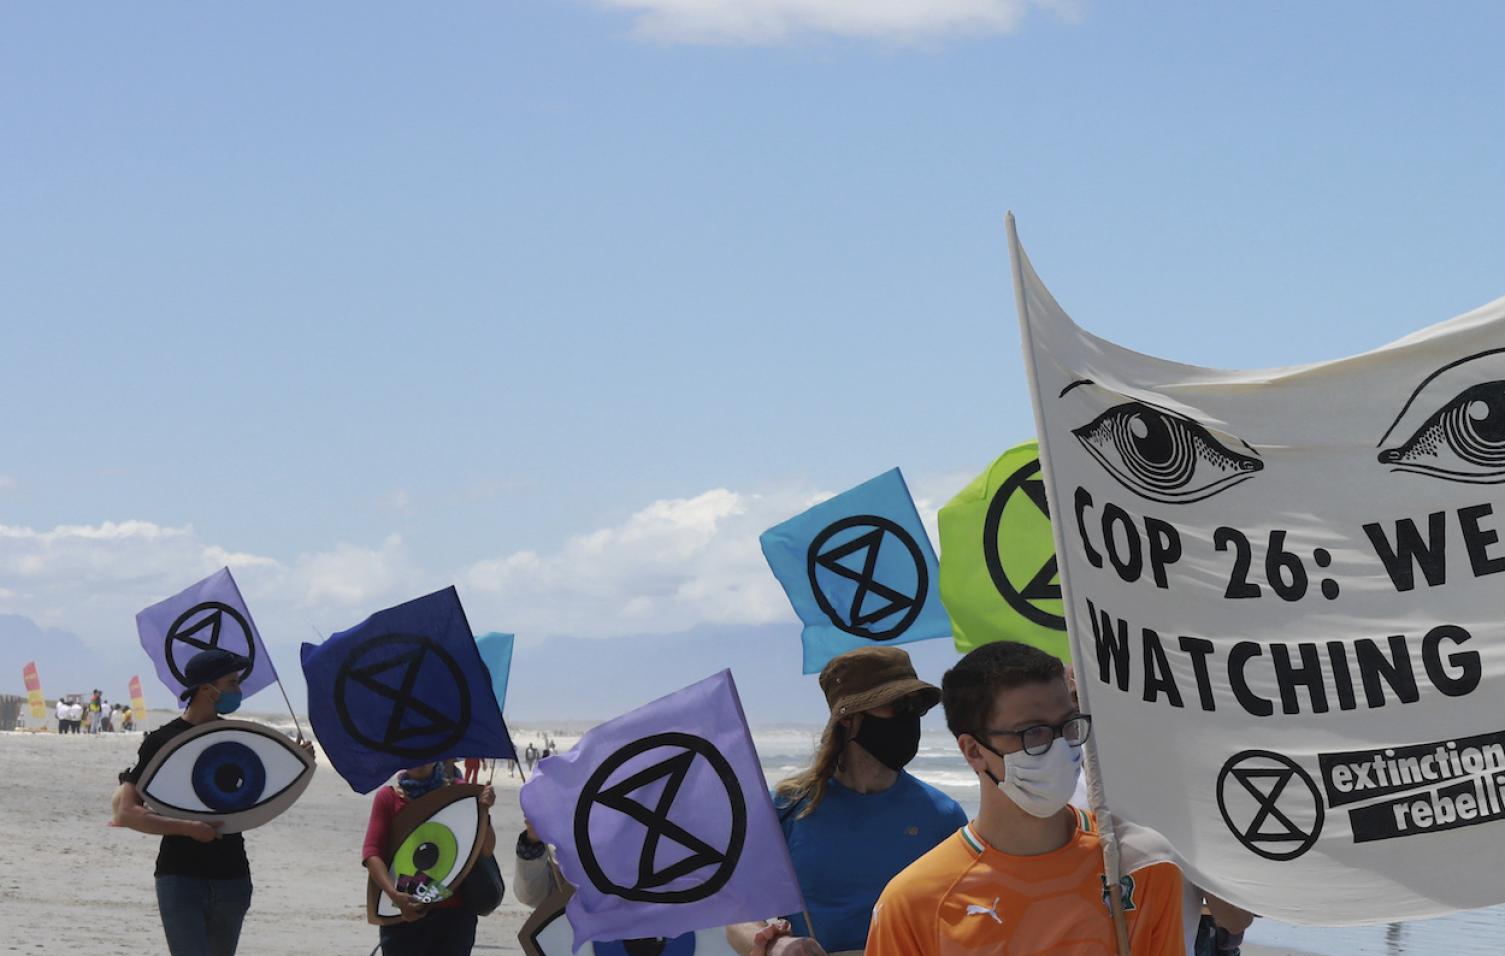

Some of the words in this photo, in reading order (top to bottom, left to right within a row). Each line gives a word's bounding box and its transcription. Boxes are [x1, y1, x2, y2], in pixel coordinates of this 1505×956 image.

[1074, 486, 1182, 589] COP
[1213, 527, 1339, 602] 26:
[1086, 597, 1481, 717] WATCHING
